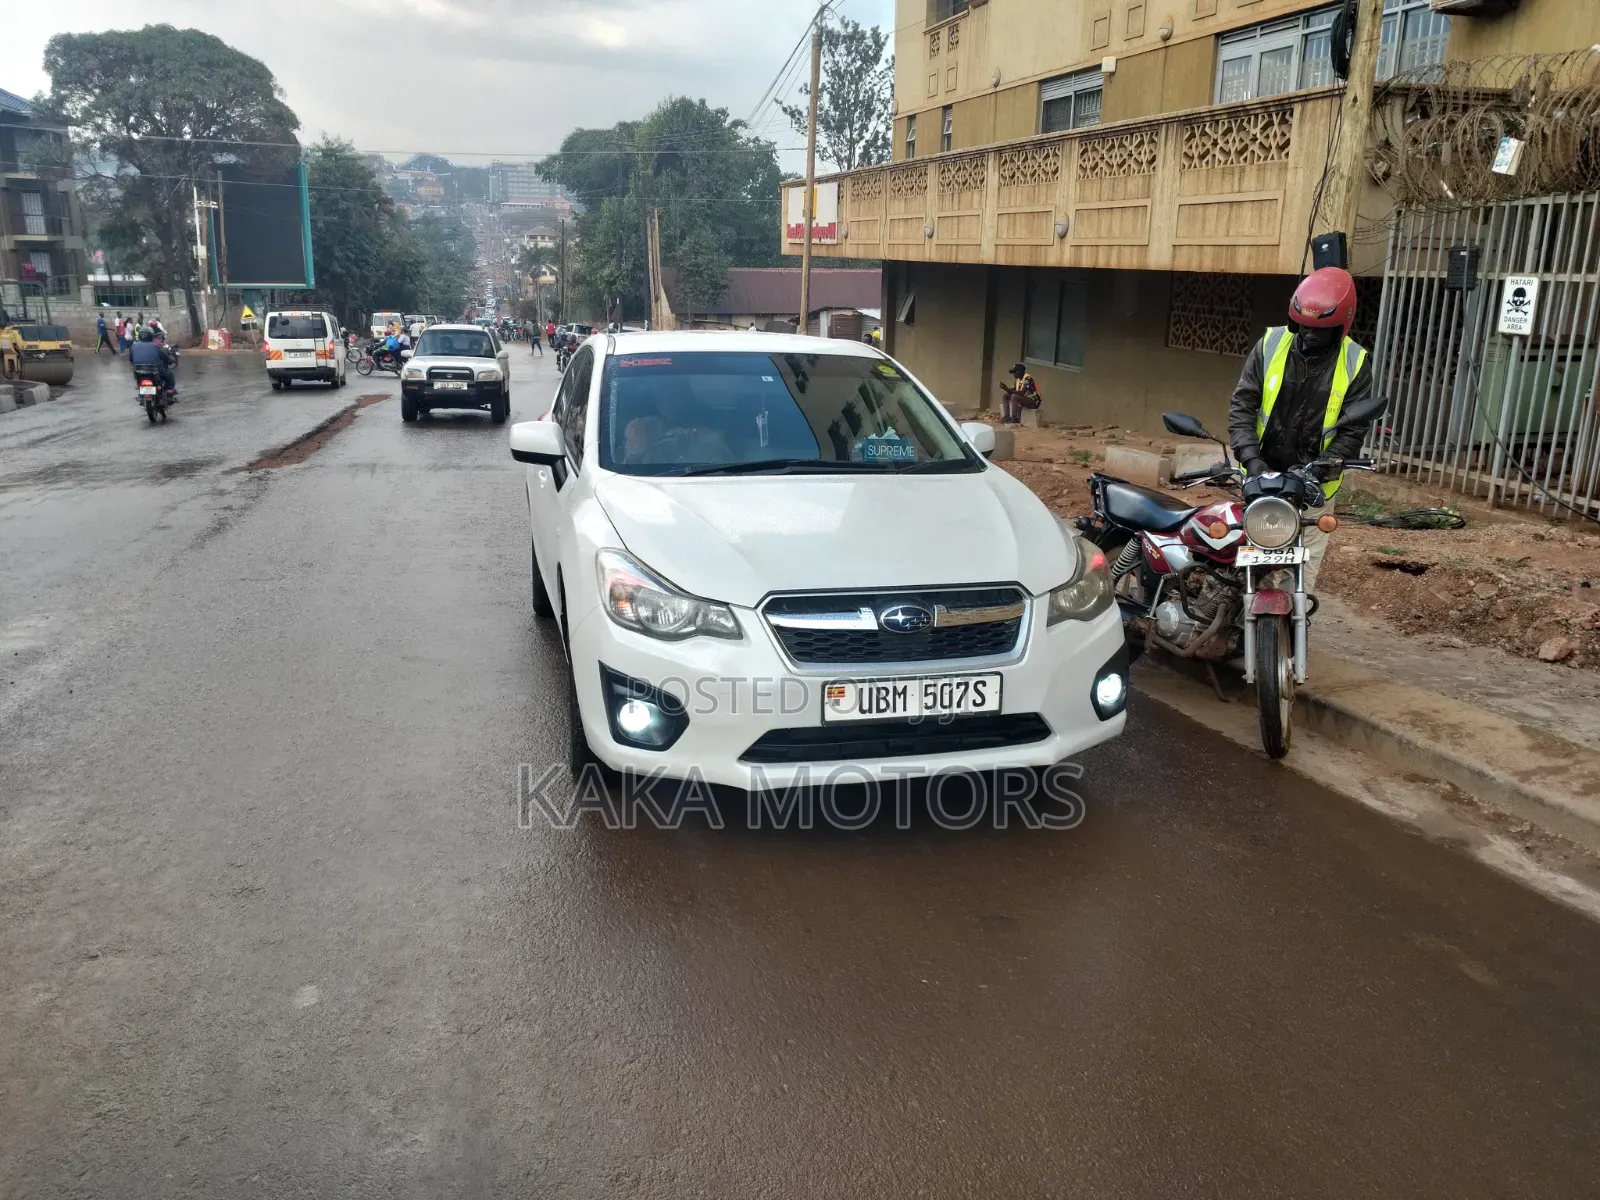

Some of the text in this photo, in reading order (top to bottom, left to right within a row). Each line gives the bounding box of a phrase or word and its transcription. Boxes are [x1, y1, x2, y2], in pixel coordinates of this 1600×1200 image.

[1510, 278, 1533, 286] HATARI
[1503, 316, 1528, 324] DANGER
[867, 444, 915, 457] SUPREME
[858, 680, 988, 715] UBM 507S
